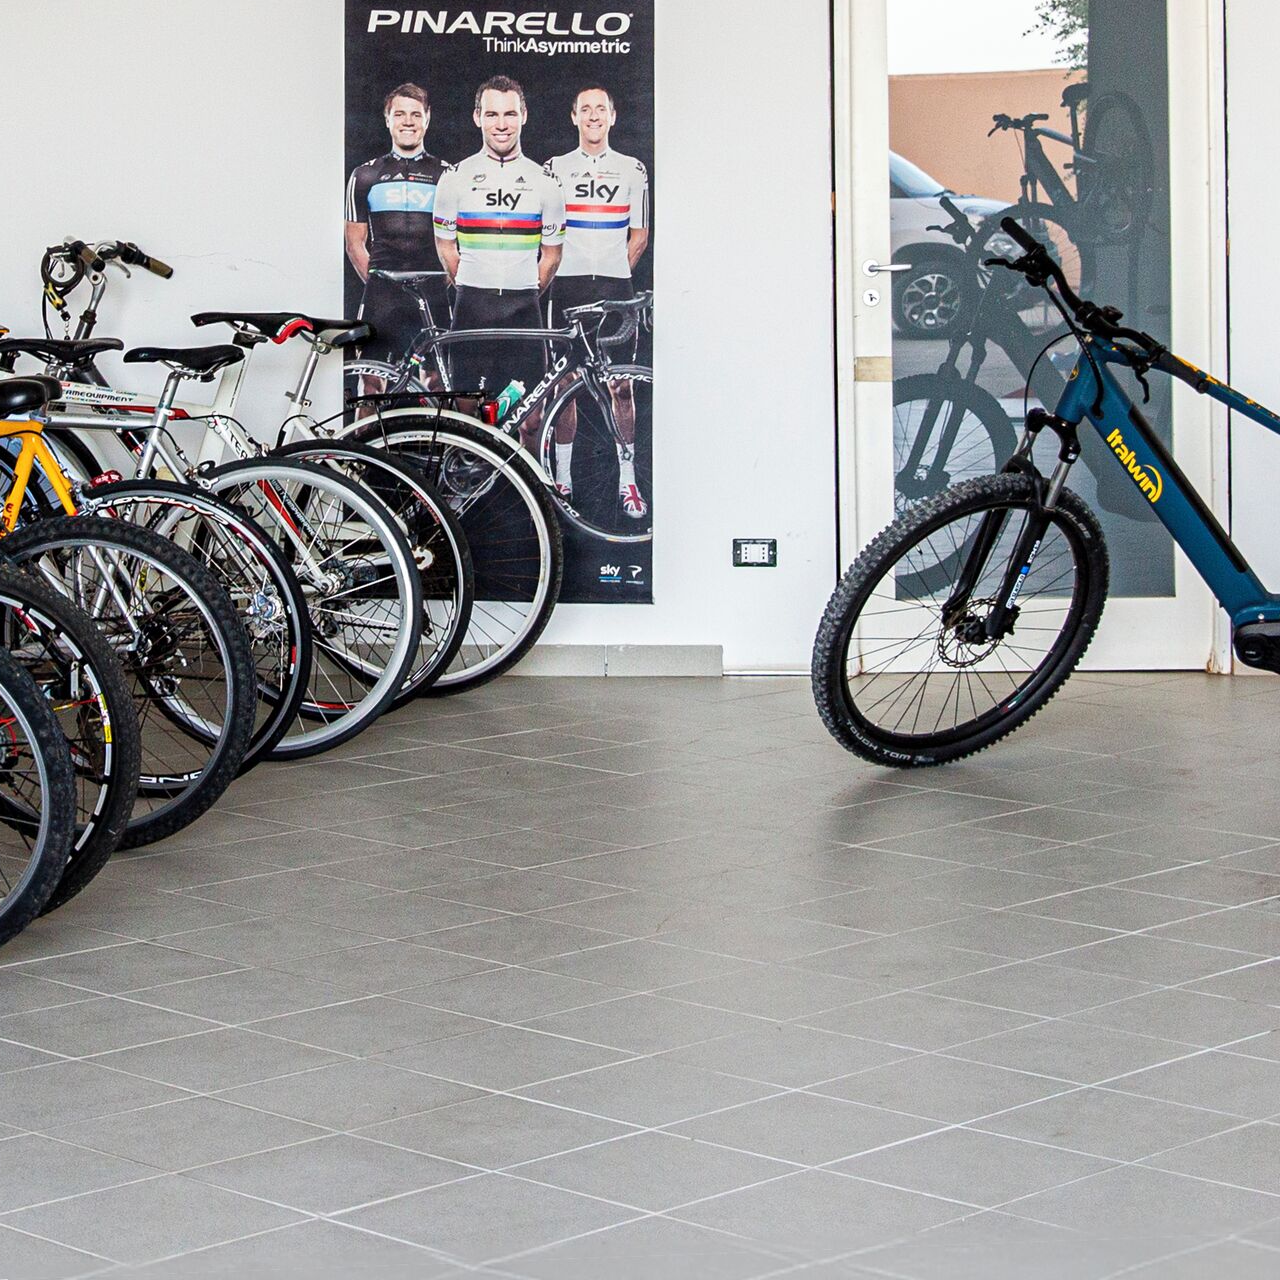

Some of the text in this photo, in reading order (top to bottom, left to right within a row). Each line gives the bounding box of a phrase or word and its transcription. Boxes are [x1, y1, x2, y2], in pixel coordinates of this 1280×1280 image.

[367, 10, 632, 36] PINARELLO
[483, 37, 632, 56] ThinkAsymmetric
[386, 184, 434, 208] sky
[486, 188, 522, 211] sky
[575, 180, 620, 204] sky
[502, 356, 568, 433] INARELLO
[1106, 428, 1163, 503] Italwin
[600, 564, 621, 576] sky
